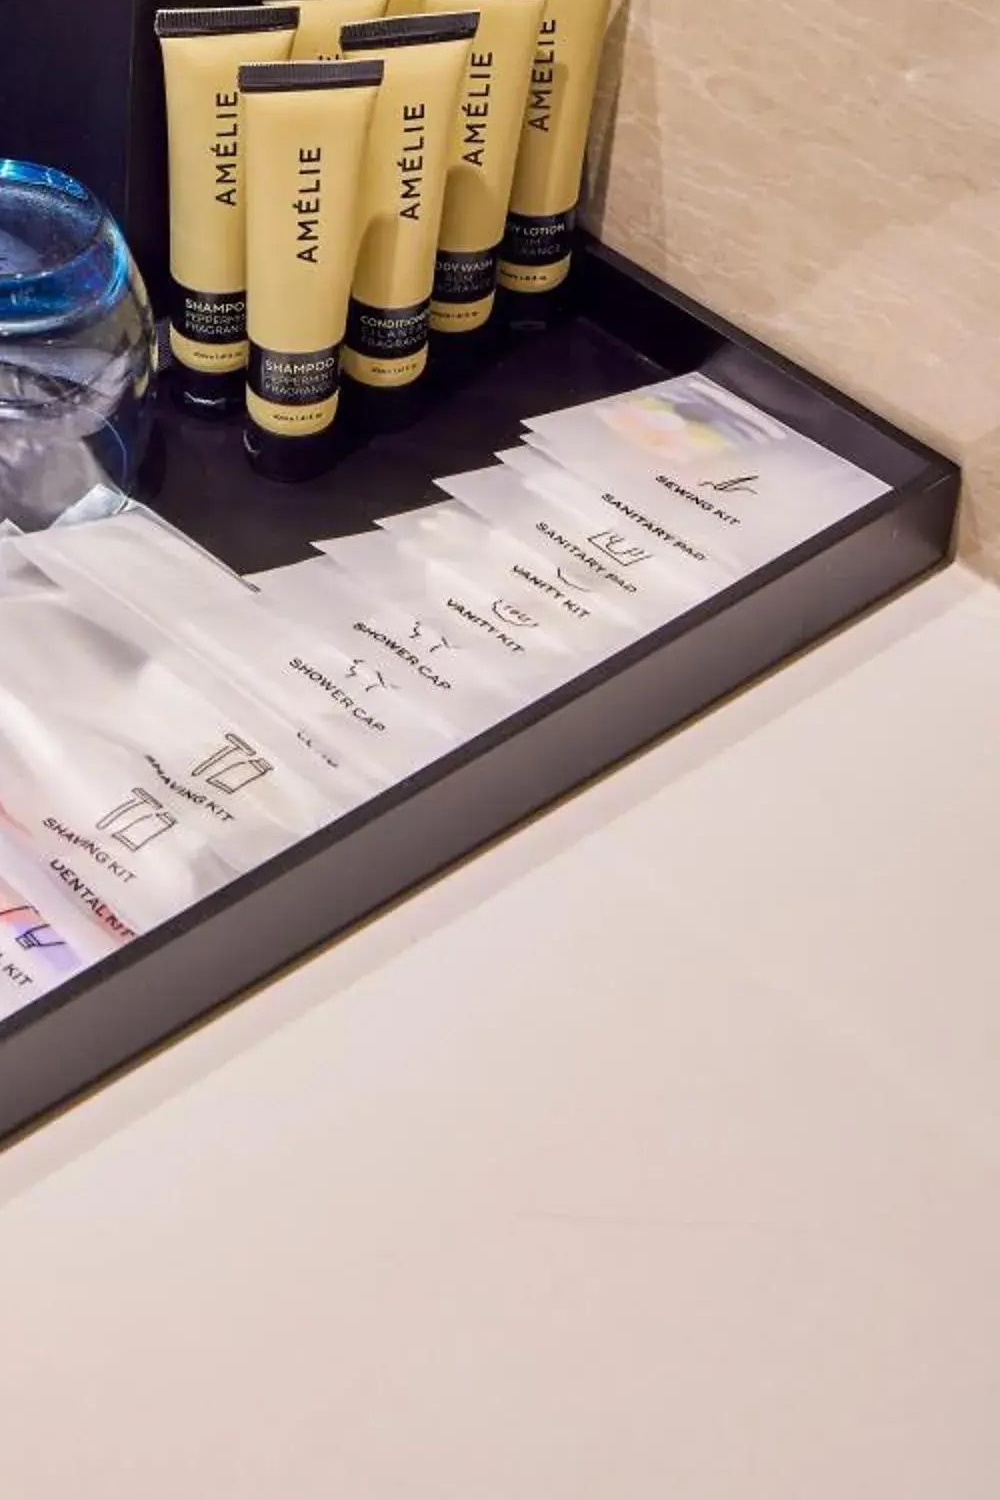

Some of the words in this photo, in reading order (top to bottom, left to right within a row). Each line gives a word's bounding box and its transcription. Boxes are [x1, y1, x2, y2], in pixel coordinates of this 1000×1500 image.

[461, 51, 494, 167] AMÉLIE
[209, 92, 239, 207] AMÉLIE
[397, 103, 426, 220] AMÉLIE
[292, 147, 321, 263] AMÉLIE
[523, 223, 565, 236] LOTION
[185, 298, 245, 314] SHAMPO
[265, 357, 335, 375] SHAMPOO
[601, 493, 676, 542] SANITARY
[673, 540, 707, 561] PAD
[655, 475, 714, 511] SEWING
[713, 508, 741, 525] KIT
[536, 521, 607, 573] SANITARY
[604, 572, 638, 593] PAD
[512, 564, 565, 599] VANITY
[563, 599, 591, 618] KIT
[353, 621, 420, 666] SHOWER
[417, 664, 452, 689] CAP
[446, 598, 500, 633] VANITY
[495, 632, 526, 652] KIT
[289, 657, 354, 708] SHOWER
[352, 707, 386, 731] CAP
[204, 801, 235, 822] KIT
[43, 817, 111, 863] SHAVING
[107, 861, 138, 883] KIT
[105, 913, 137, 938] KIT
[1, 962, 34, 987] KIT
